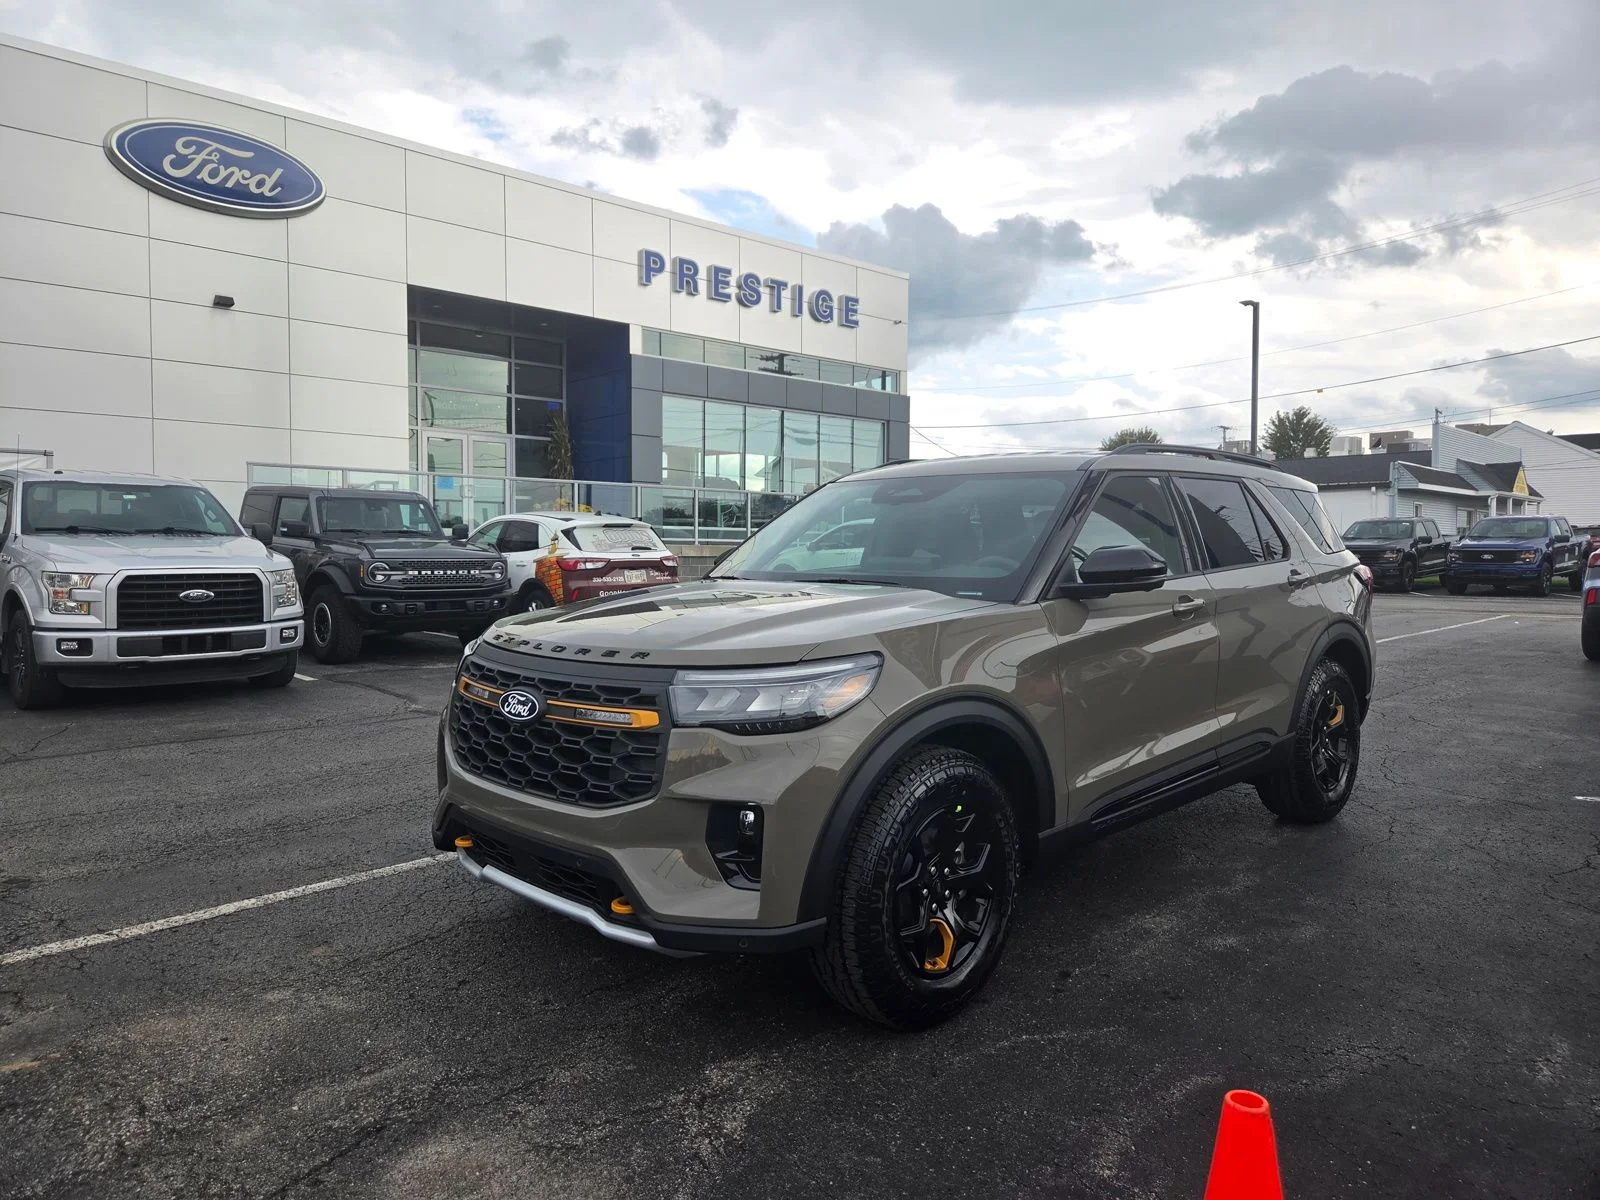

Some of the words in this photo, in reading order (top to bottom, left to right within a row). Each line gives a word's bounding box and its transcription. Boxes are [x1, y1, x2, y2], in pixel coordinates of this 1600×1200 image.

[162, 136, 284, 197] Ford
[638, 248, 860, 328] PRESTIGE
[492, 634, 650, 659] EXPLORER
[503, 693, 532, 717] Ford
